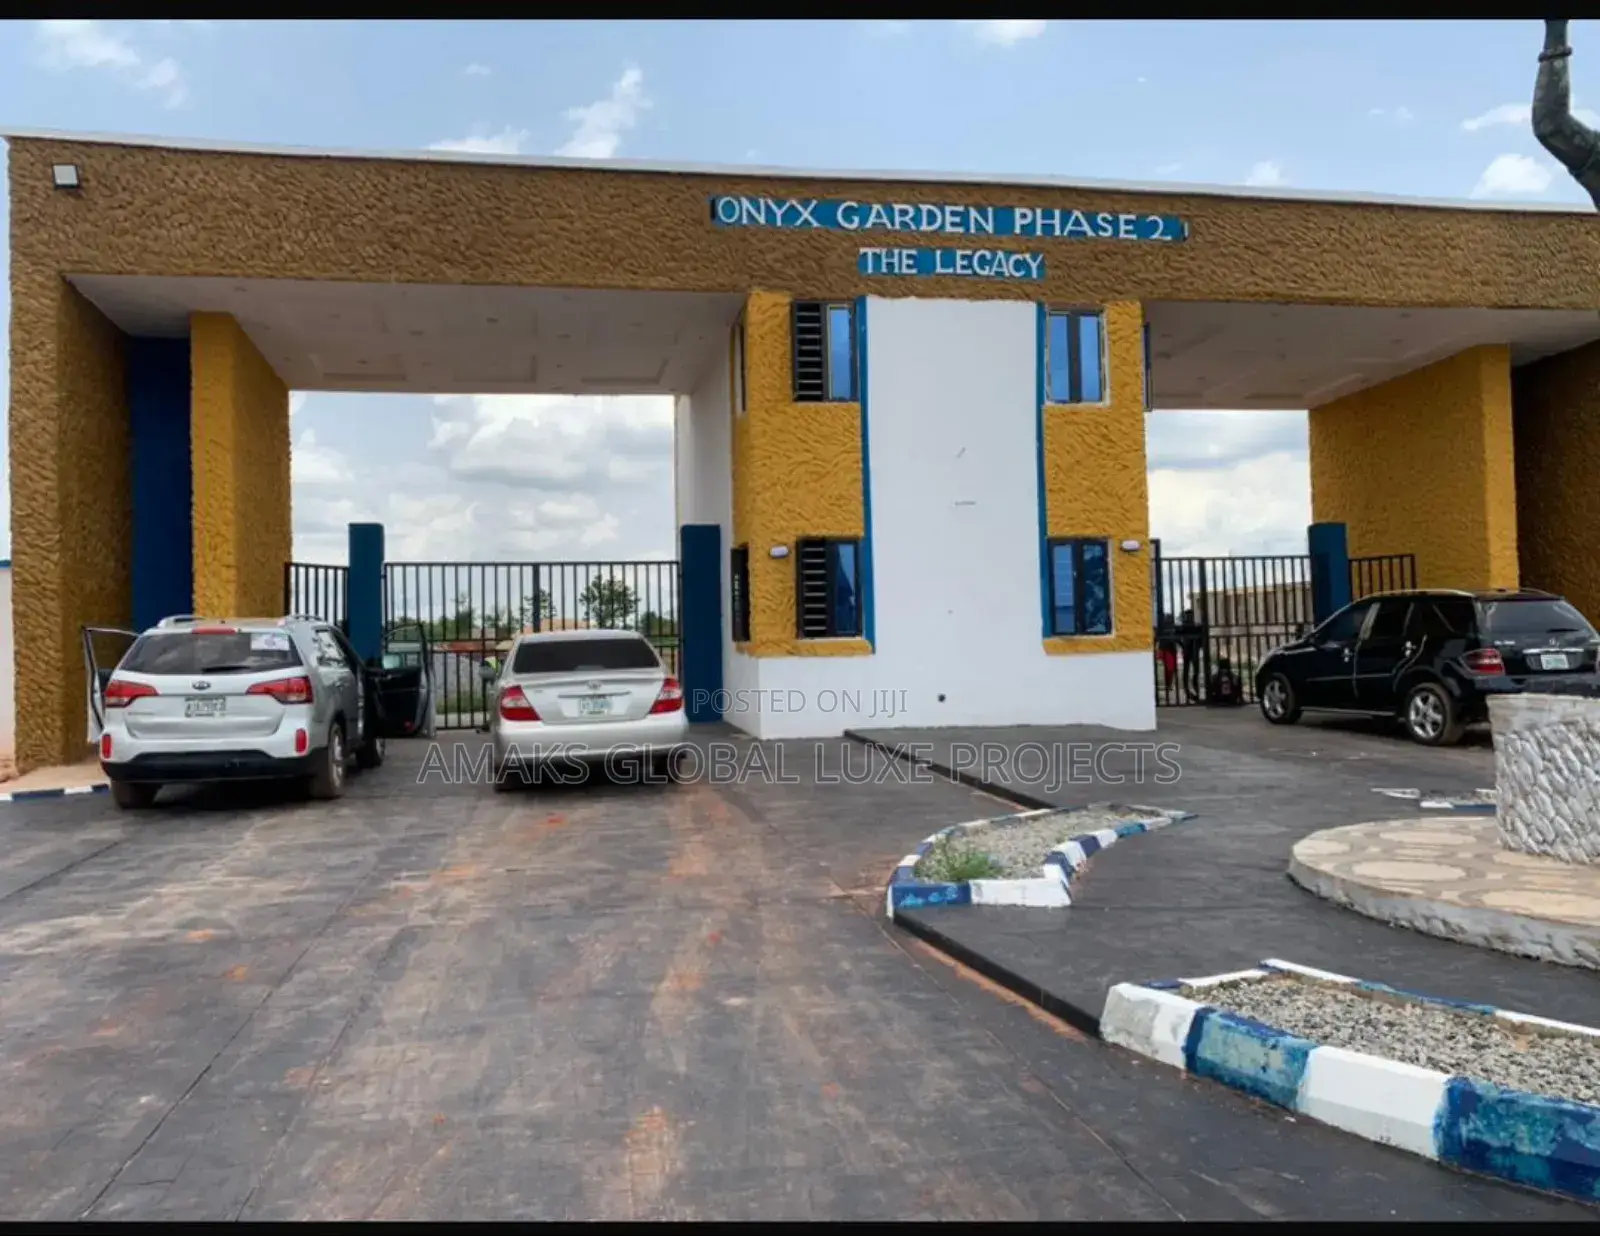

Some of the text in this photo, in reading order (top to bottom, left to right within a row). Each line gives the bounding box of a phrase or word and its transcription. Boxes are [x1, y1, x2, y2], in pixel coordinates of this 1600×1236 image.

[717, 196, 1172, 240] ONYX GARDEN PHASE 2
[858, 247, 1044, 279] THE LEGACY
